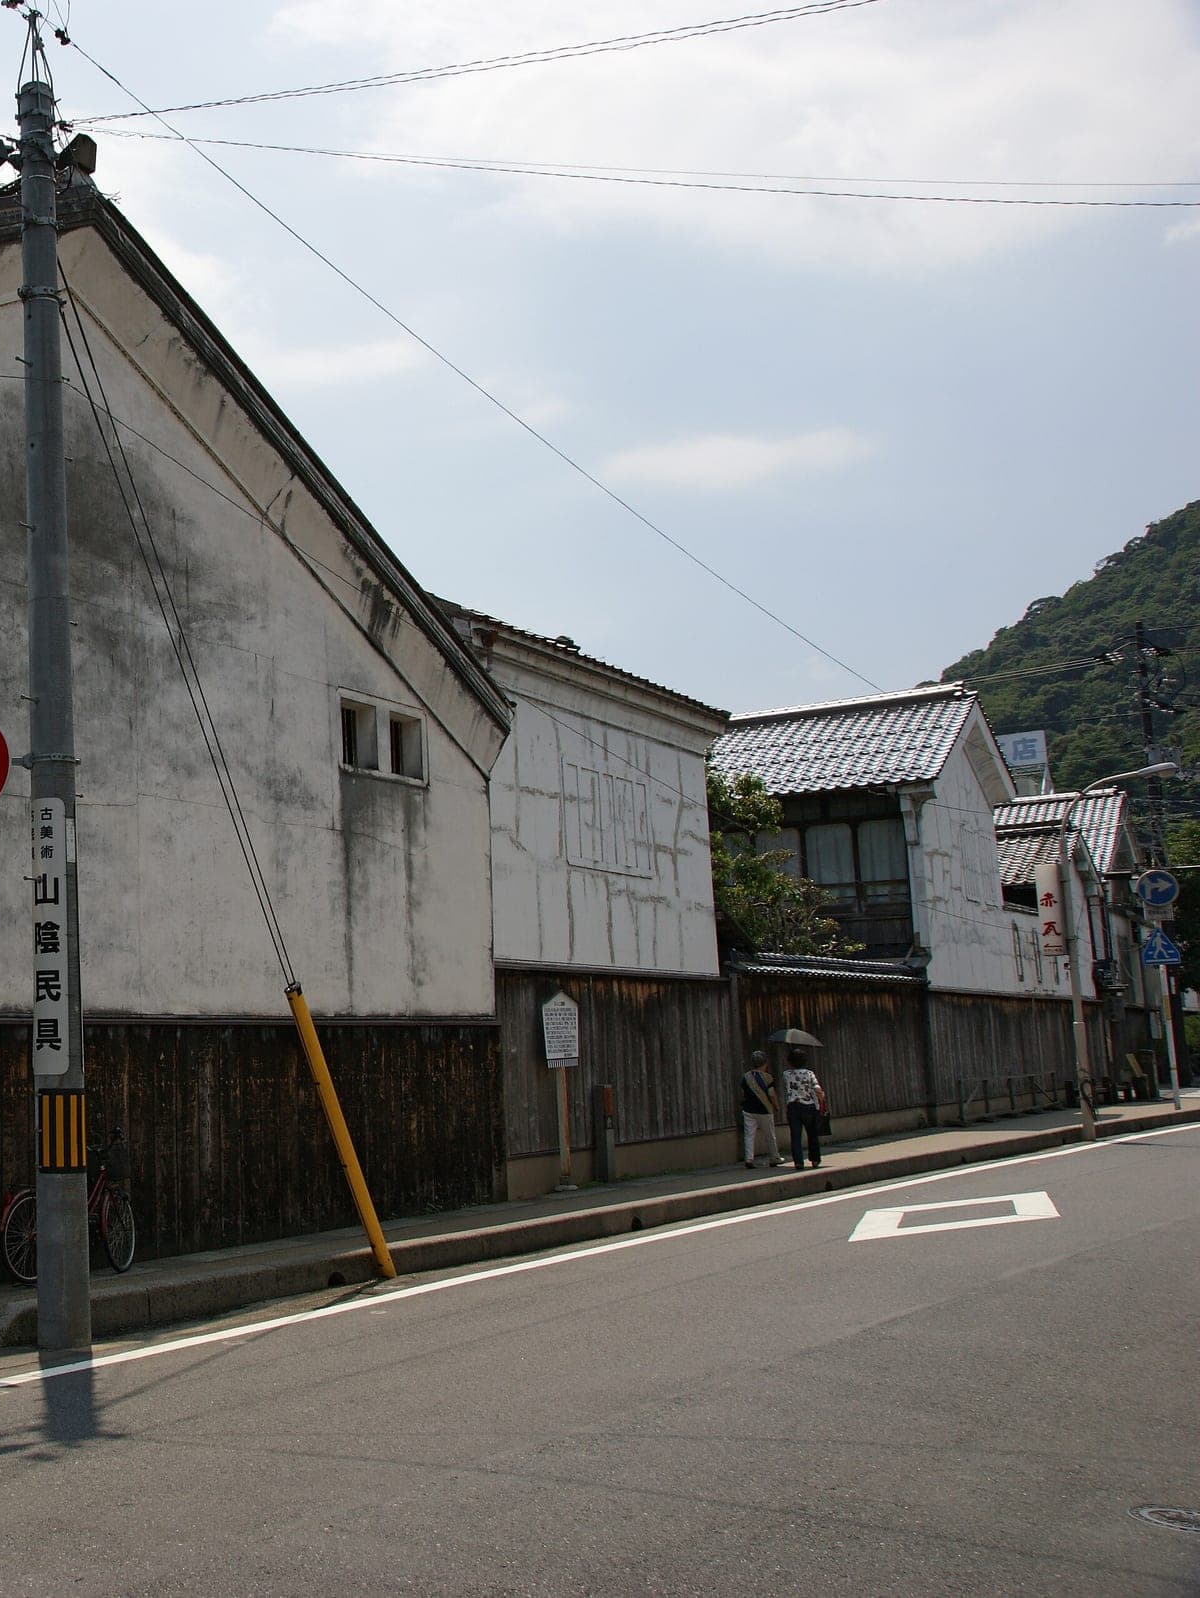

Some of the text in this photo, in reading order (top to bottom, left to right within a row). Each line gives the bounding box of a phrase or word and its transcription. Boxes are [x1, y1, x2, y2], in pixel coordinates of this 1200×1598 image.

[1000, 736, 1037, 761] 店
[34, 807, 61, 1051] 古美術 山陰民具
[1039, 892, 1062, 936] 赤瓦
